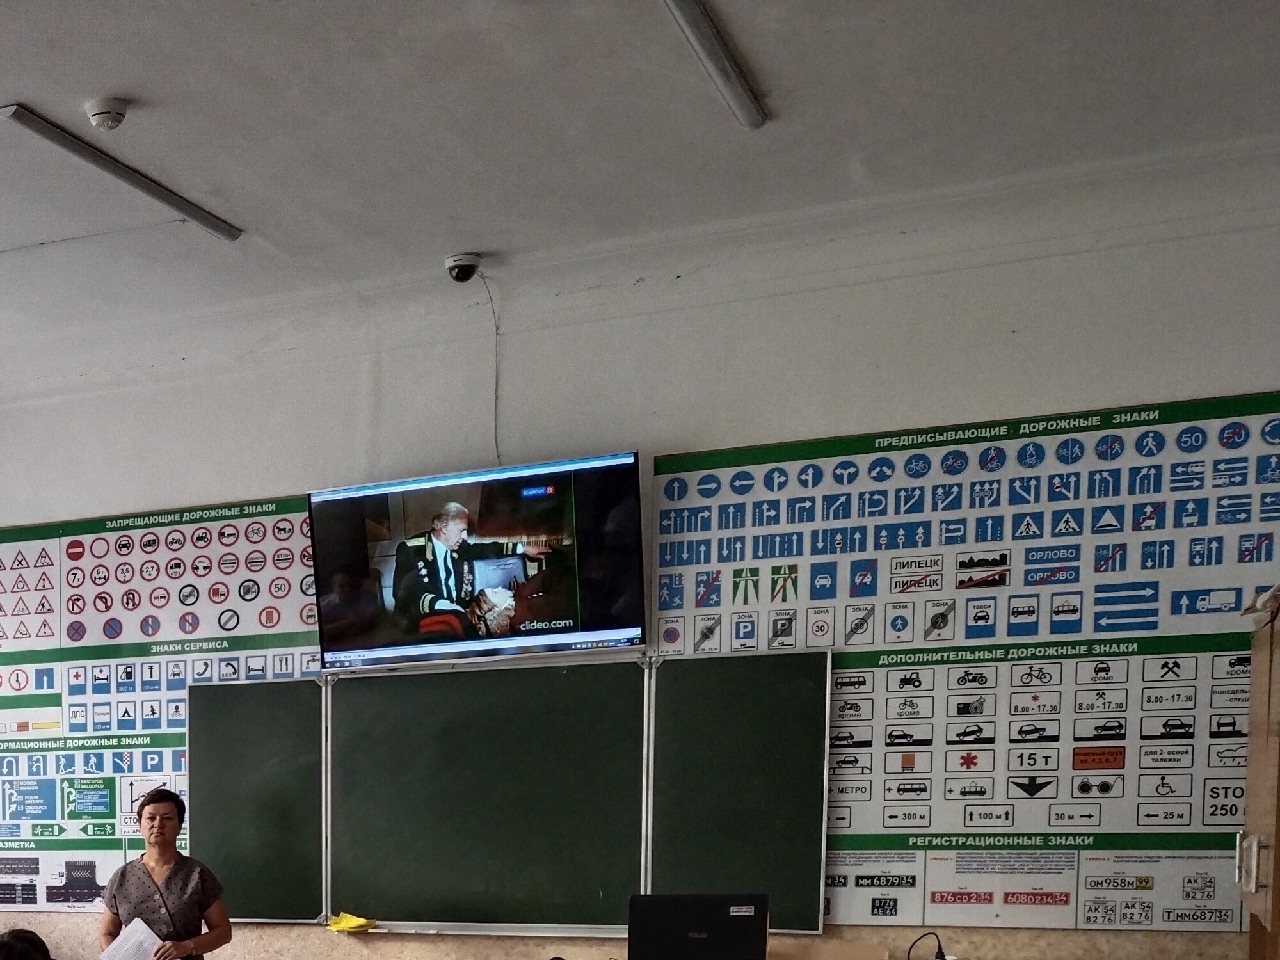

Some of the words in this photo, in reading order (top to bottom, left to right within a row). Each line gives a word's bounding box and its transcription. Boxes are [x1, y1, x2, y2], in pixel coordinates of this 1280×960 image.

[875, 424, 1008, 448] ПРЕДПИСЫВАЮЩИЕ
[1019, 415, 1101, 435] ДОРОЖНЫЕ
[1111, 410, 1159, 424] ЗНАКИ
[1180, 432, 1203, 447] 50
[105, 513, 181, 529] ЗАПРЕЩАЮЩИЕ
[182, 506, 241, 521] ДОРОЖНЫЕ
[242, 503, 276, 514] ЗНАКИ
[1028, 549, 1076, 561] ОРЛОВО
[894, 559, 940, 571] ЛИПЕЦК
[274, 583, 286, 592] 50
[893, 578, 940, 589] ЛИПЕЦК
[520, 617, 574, 631] clideo.com
[815, 624, 825, 633] 30
[150, 643, 182, 653] ЗНАКИ
[184, 641, 229, 651] СЕРВИСА
[878, 650, 1006, 665] ДОПОЛНИТЕЛЬНЫЕ
[1008, 645, 1088, 660] ДОРОЖНЫЕ
[1091, 643, 1138, 654] ЗНАКИ
[66, 738, 119, 749] ДОРОЖНЫЕ
[120, 736, 151, 746] ЗНАКИ
[1018, 753, 1037, 767] 15
[837, 785, 868, 795] МЕТРО
[1209, 786, 1245, 799] STO
[978, 812, 994, 820] 100
[1163, 811, 1175, 820] 25
[1209, 803, 1239, 817] 250
[1054, 812, 1066, 821] 30
[908, 836, 1044, 847] РЕГИСТРАЦИОННЫЕ
[1047, 836, 1094, 846] ЗНАКИ
[873, 876, 900, 887] 6879
